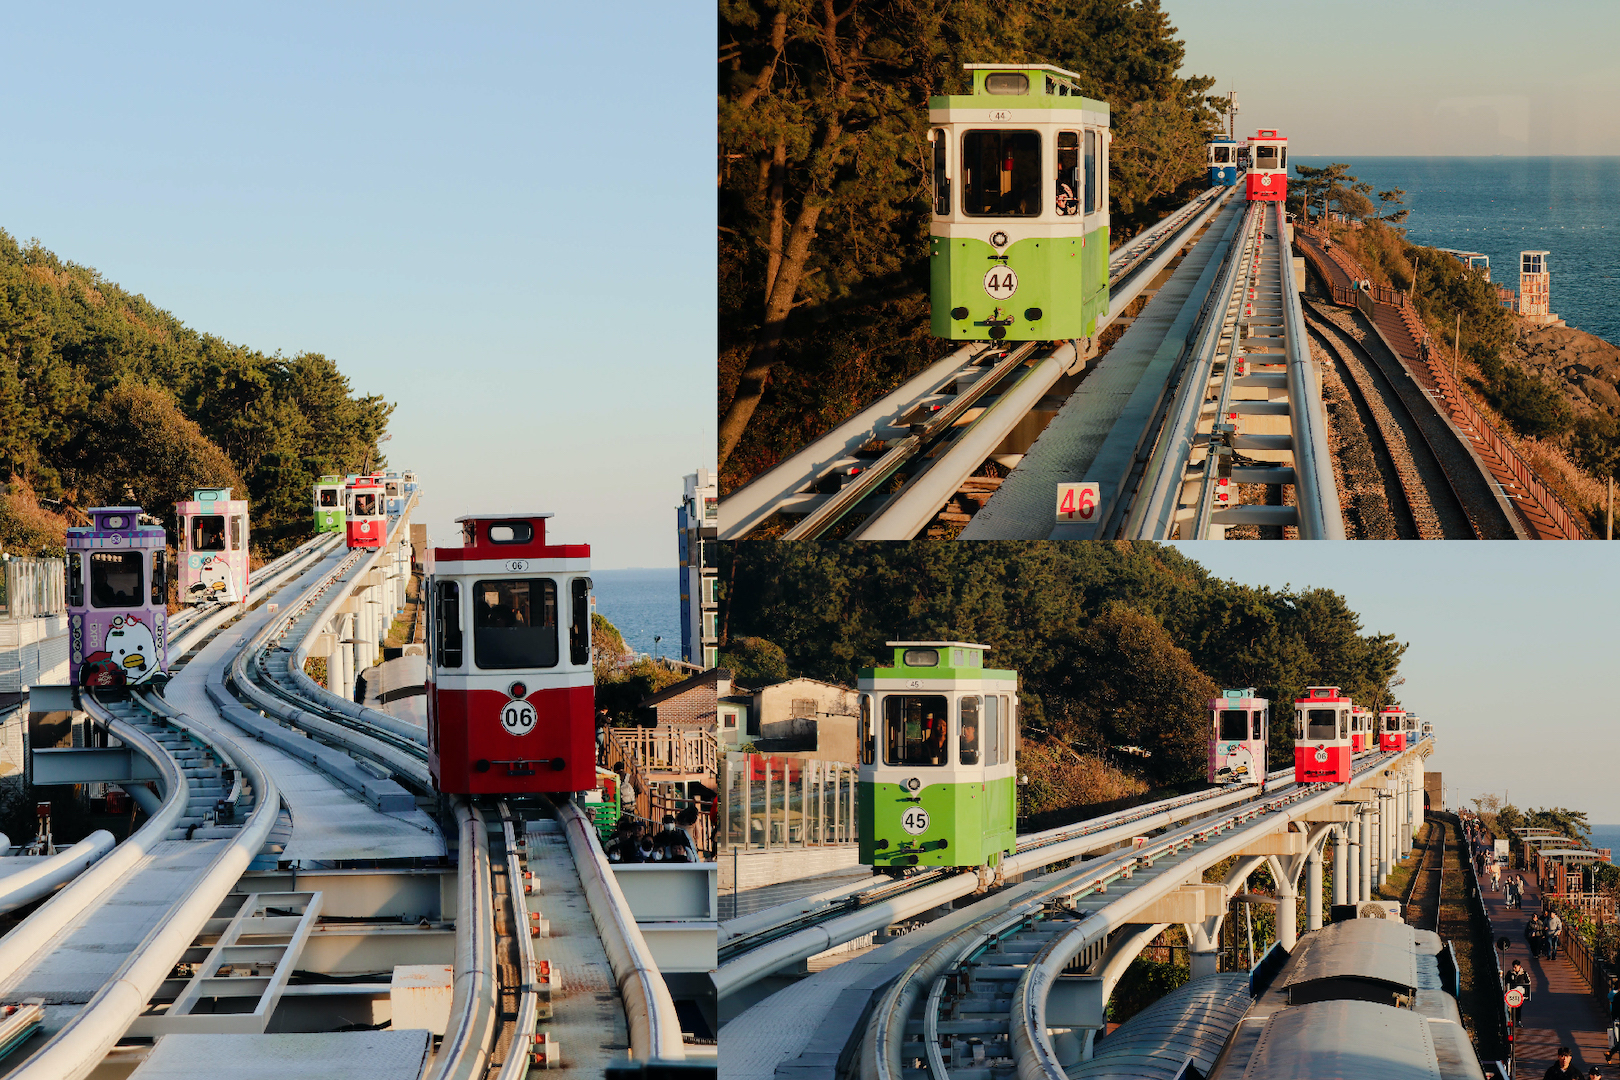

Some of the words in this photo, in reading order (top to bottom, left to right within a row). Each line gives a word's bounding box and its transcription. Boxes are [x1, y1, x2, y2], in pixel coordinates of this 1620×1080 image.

[995, 112, 1005, 120] 44
[988, 273, 1014, 292] 44
[1060, 488, 1095, 520] 46
[511, 561, 523, 570] 06
[270, 605, 276, 613] 7
[90, 623, 98, 648] EXPO
[910, 680, 919, 688] 45
[505, 707, 533, 728] 06
[905, 813, 926, 829] 45
[1136, 838, 1144, 849] 7
